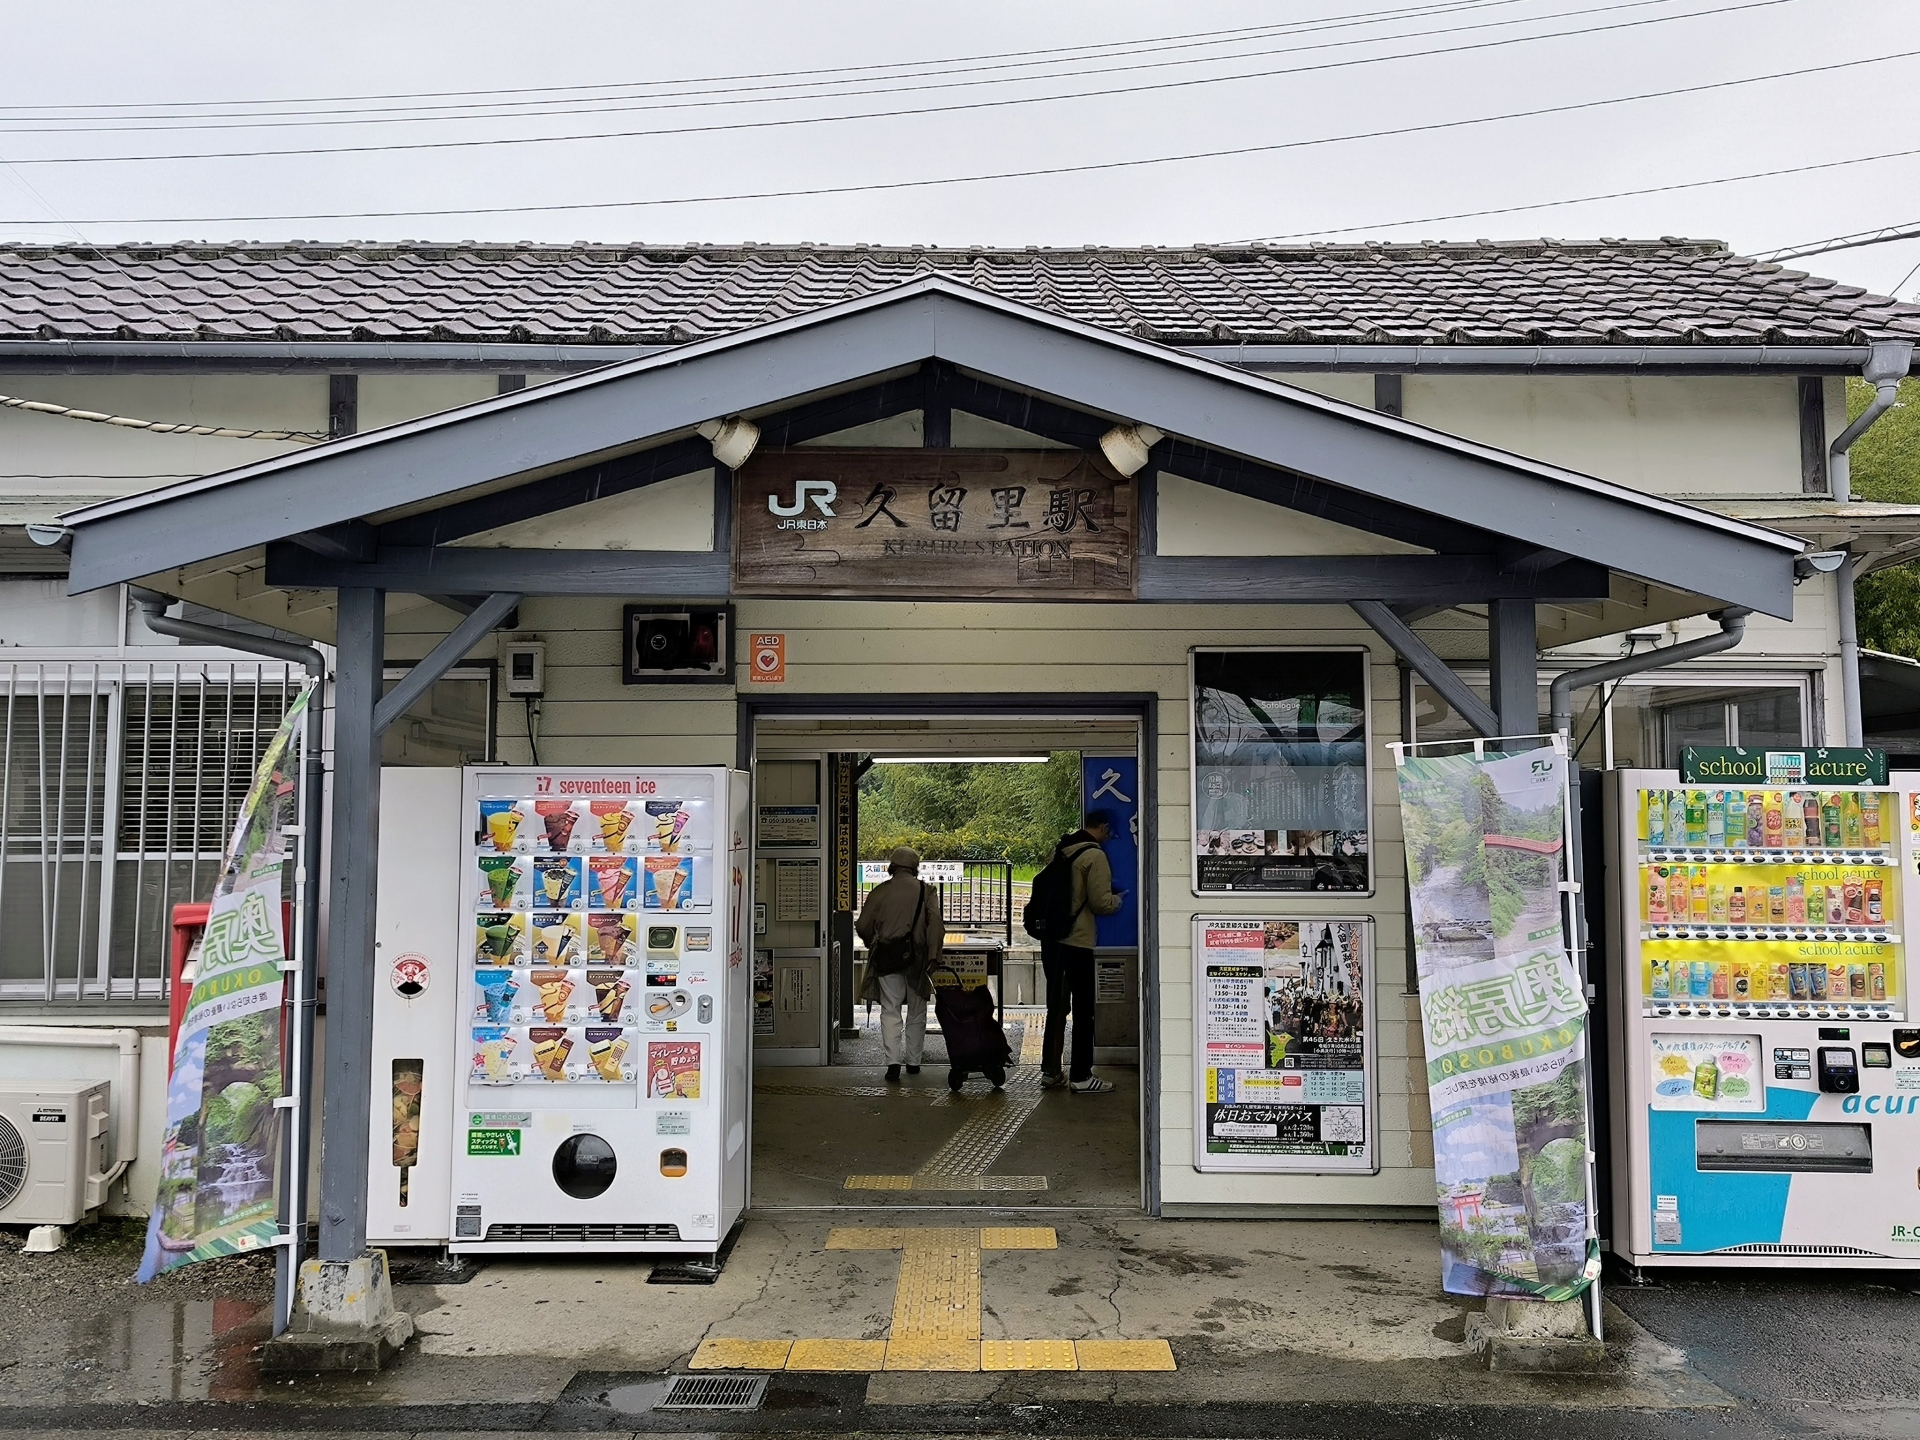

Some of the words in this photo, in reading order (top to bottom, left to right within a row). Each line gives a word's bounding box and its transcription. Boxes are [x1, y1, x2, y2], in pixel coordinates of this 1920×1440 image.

[768, 480, 837, 517] JR
[854, 481, 1103, 534] 久留里駅
[777, 519, 828, 531] JR東日本
[756, 636, 780, 645] AED
[1700, 755, 1764, 777] school
[1809, 761, 1868, 777] acure
[559, 778, 632, 794] seventeen
[635, 776, 657, 794] ice
[839, 763, 850, 909] かけこみ乗車はおやめください
[1796, 867, 1839, 881] school
[1842, 869, 1881, 879] acure
[1798, 943, 1842, 955] school
[1845, 945, 1884, 955] acure
[650, 1045, 689, 1058] マイレージを
[1218, 1069, 1226, 1101] 久留里線
[1226, 1074, 1235, 1098] 時刻表
[1214, 1108, 1313, 1122] 休日おでかけパス
[1349, 1146, 1364, 1155] JR
